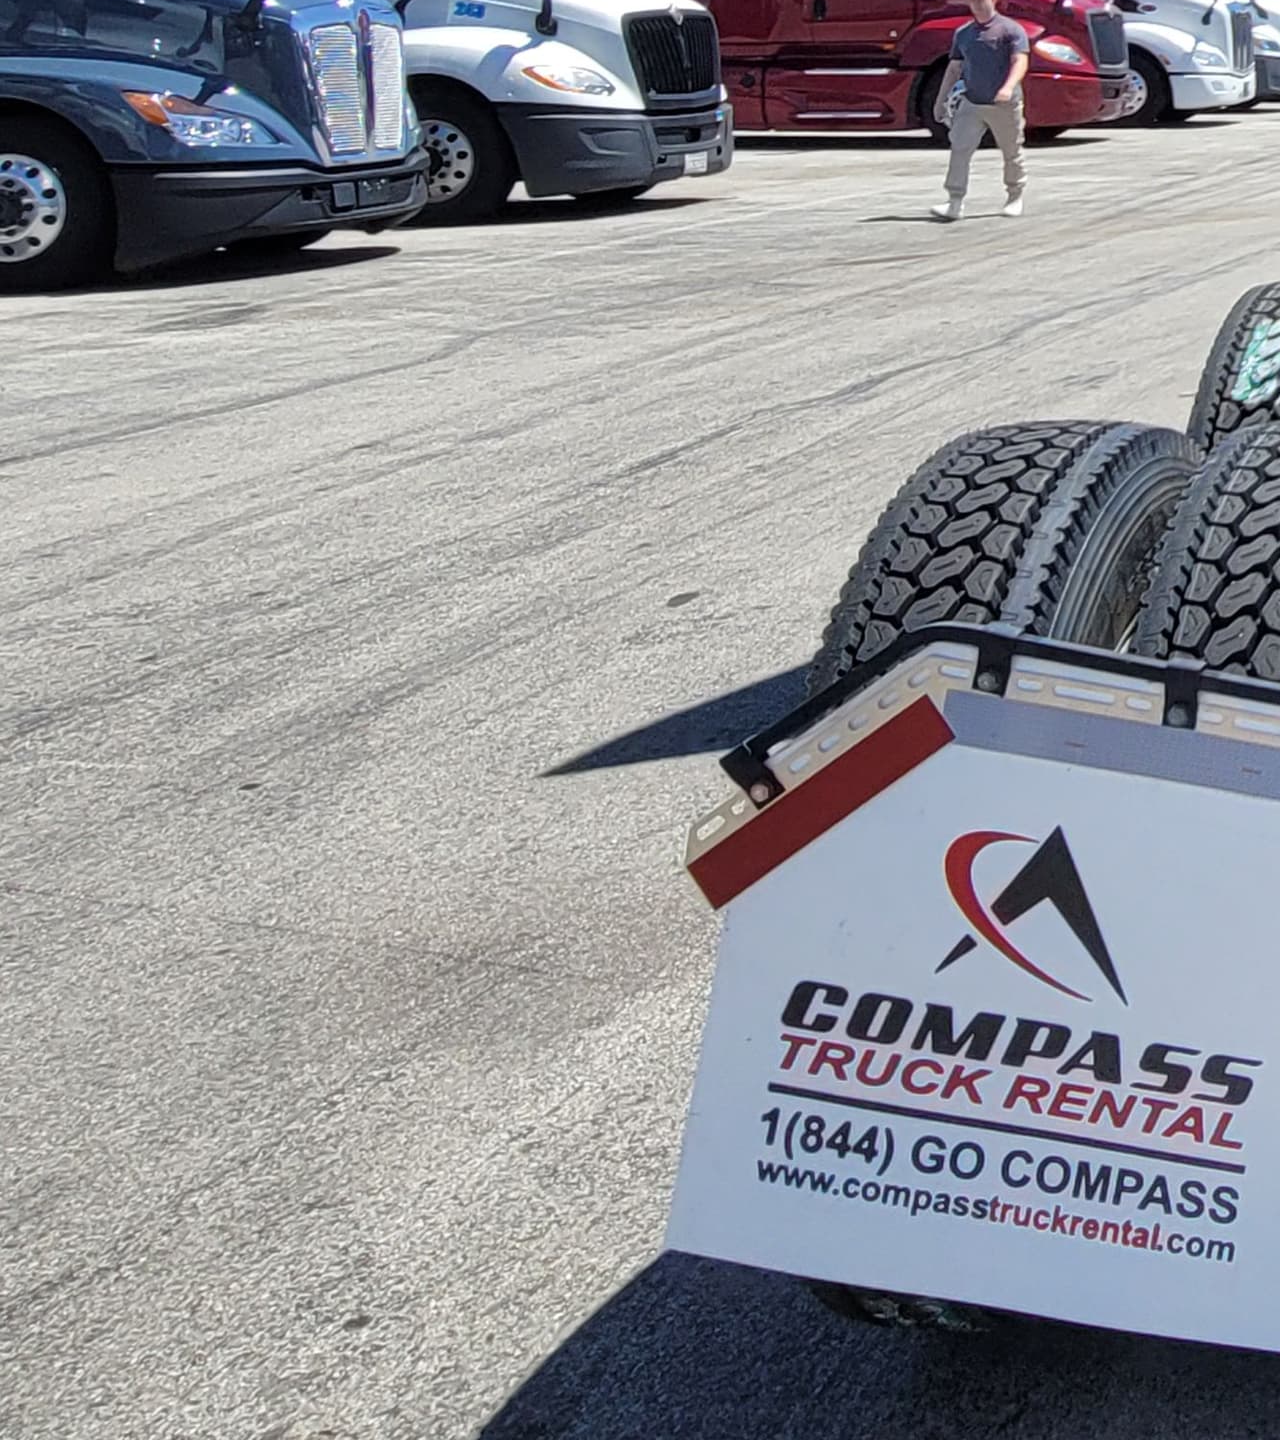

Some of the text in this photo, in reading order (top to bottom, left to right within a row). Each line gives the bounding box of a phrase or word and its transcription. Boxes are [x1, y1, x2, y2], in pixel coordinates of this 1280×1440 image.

[780, 980, 1263, 1106] COMPASS
[780, 1033, 1243, 1150] TRUCK RENTAL
[757, 1159, 1235, 1263] www.compasstruckrental.com
[760, 1107, 1240, 1225] 1(844) GO COMPASS
